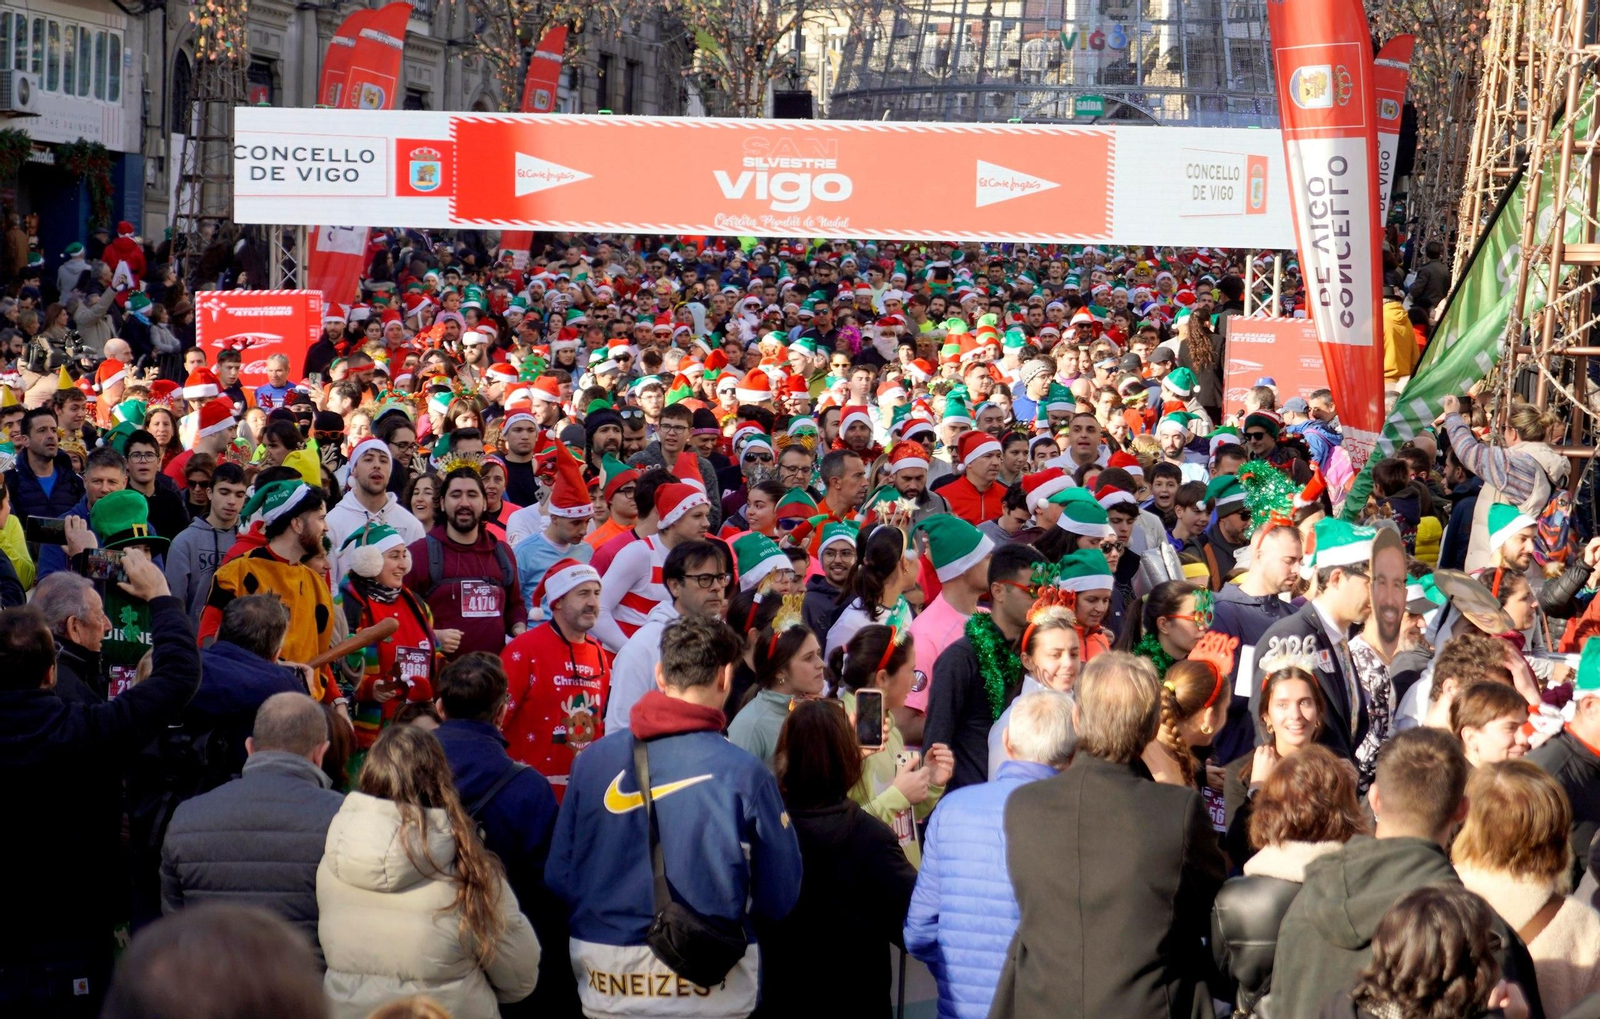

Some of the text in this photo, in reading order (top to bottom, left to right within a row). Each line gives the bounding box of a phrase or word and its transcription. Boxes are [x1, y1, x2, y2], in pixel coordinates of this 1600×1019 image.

[1076, 99, 1102, 110] SAÍDA
[44, 119, 59, 129] THE
[63, 121, 100, 135] RAINBOW
[234, 145, 375, 163] CONCELLO
[742, 136, 838, 159] SAN
[743, 157, 837, 169] SILVESTRE
[1380, 150, 1391, 187] VIGO
[250, 166, 359, 182] DE VIGO
[1186, 163, 1240, 181] CONCELLO
[713, 168, 853, 212] vigo
[988, 178, 1009, 188] Corte
[1193, 185, 1233, 200] DE VIGO
[803, 216, 814, 227] de
[817, 216, 849, 228] Nadal
[1265, 634, 1316, 658] 2026
[565, 661, 594, 675] Happy
